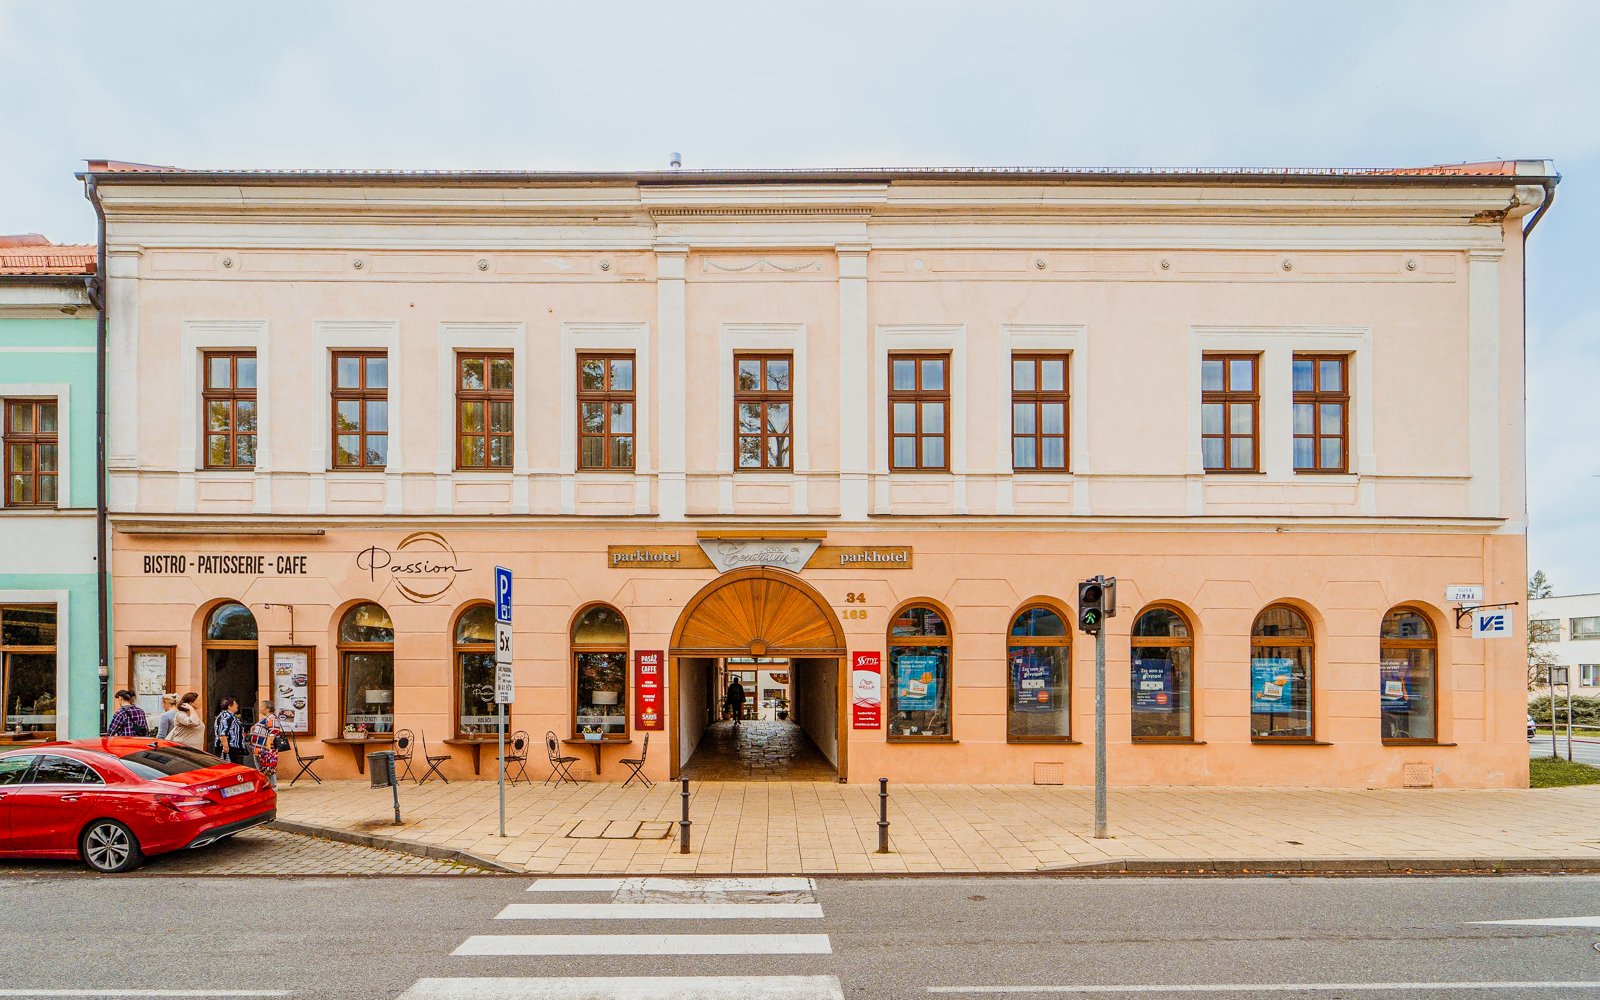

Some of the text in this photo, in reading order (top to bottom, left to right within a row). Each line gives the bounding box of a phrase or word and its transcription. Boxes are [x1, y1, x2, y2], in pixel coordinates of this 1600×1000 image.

[613, 550, 680, 565] parkhotel
[717, 541, 801, 567] Centrum
[840, 550, 908, 565] parkhotel
[143, 556, 186, 574] BISTRO
[198, 556, 264, 574] PATISSERIE
[277, 556, 307, 574] CAFE
[356, 546, 472, 582] Passion
[501, 574, 508, 604] P
[847, 593, 866, 604] 34
[841, 609, 867, 620] 168
[499, 631, 510, 652] 5x
[641, 666, 657, 674] CAFFE
